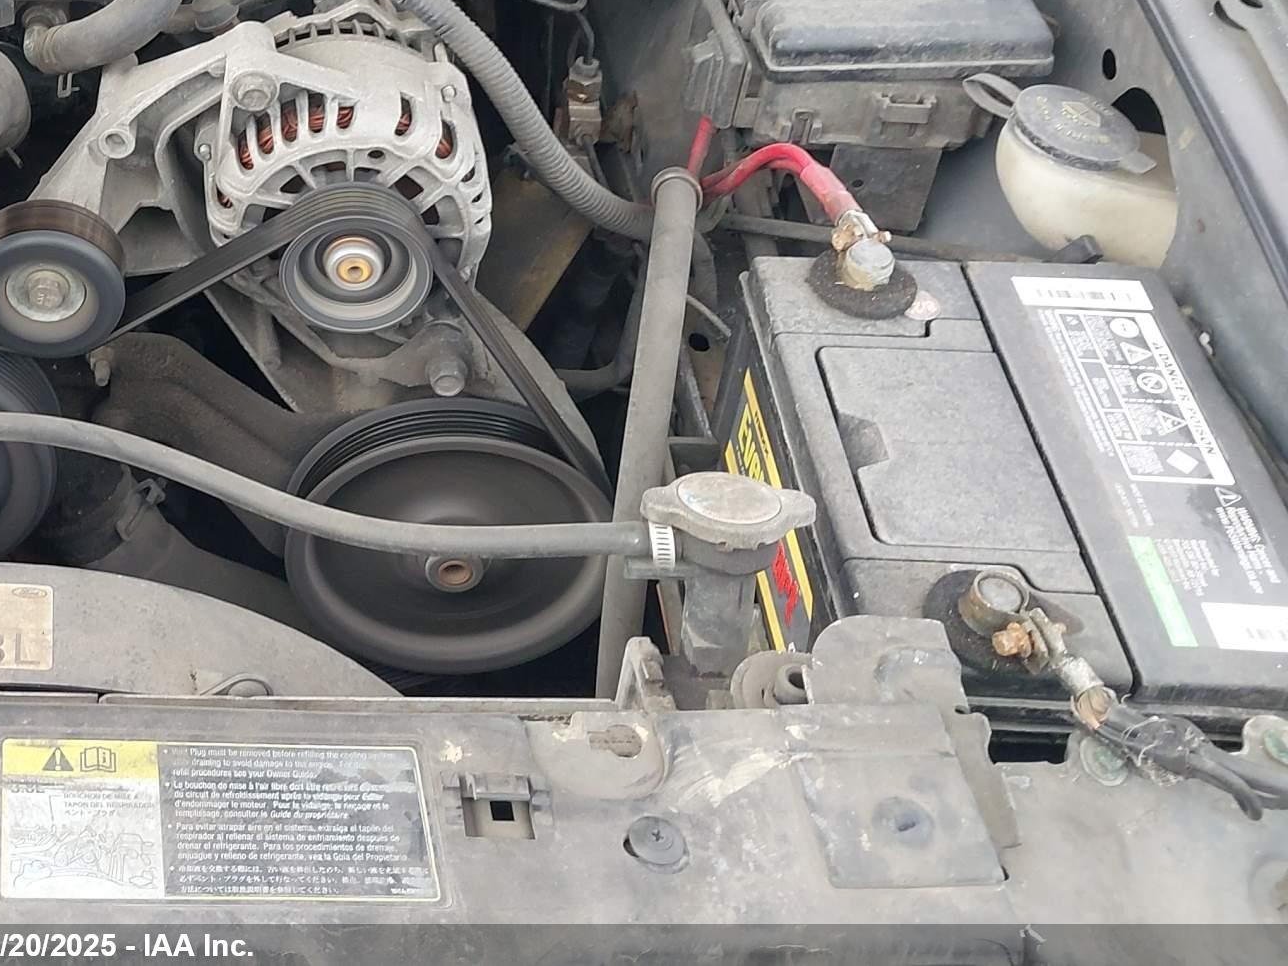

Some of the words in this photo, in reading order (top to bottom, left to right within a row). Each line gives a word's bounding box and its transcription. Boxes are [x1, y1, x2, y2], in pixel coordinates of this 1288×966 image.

[176, 822, 193, 830] Para
[195, 823, 216, 831] evitar
[176, 832, 214, 841] respirador
[255, 833, 263, 841] el
[177, 842, 201, 850] drenar
[203, 842, 211, 850] el
[263, 842, 281, 850] Para
